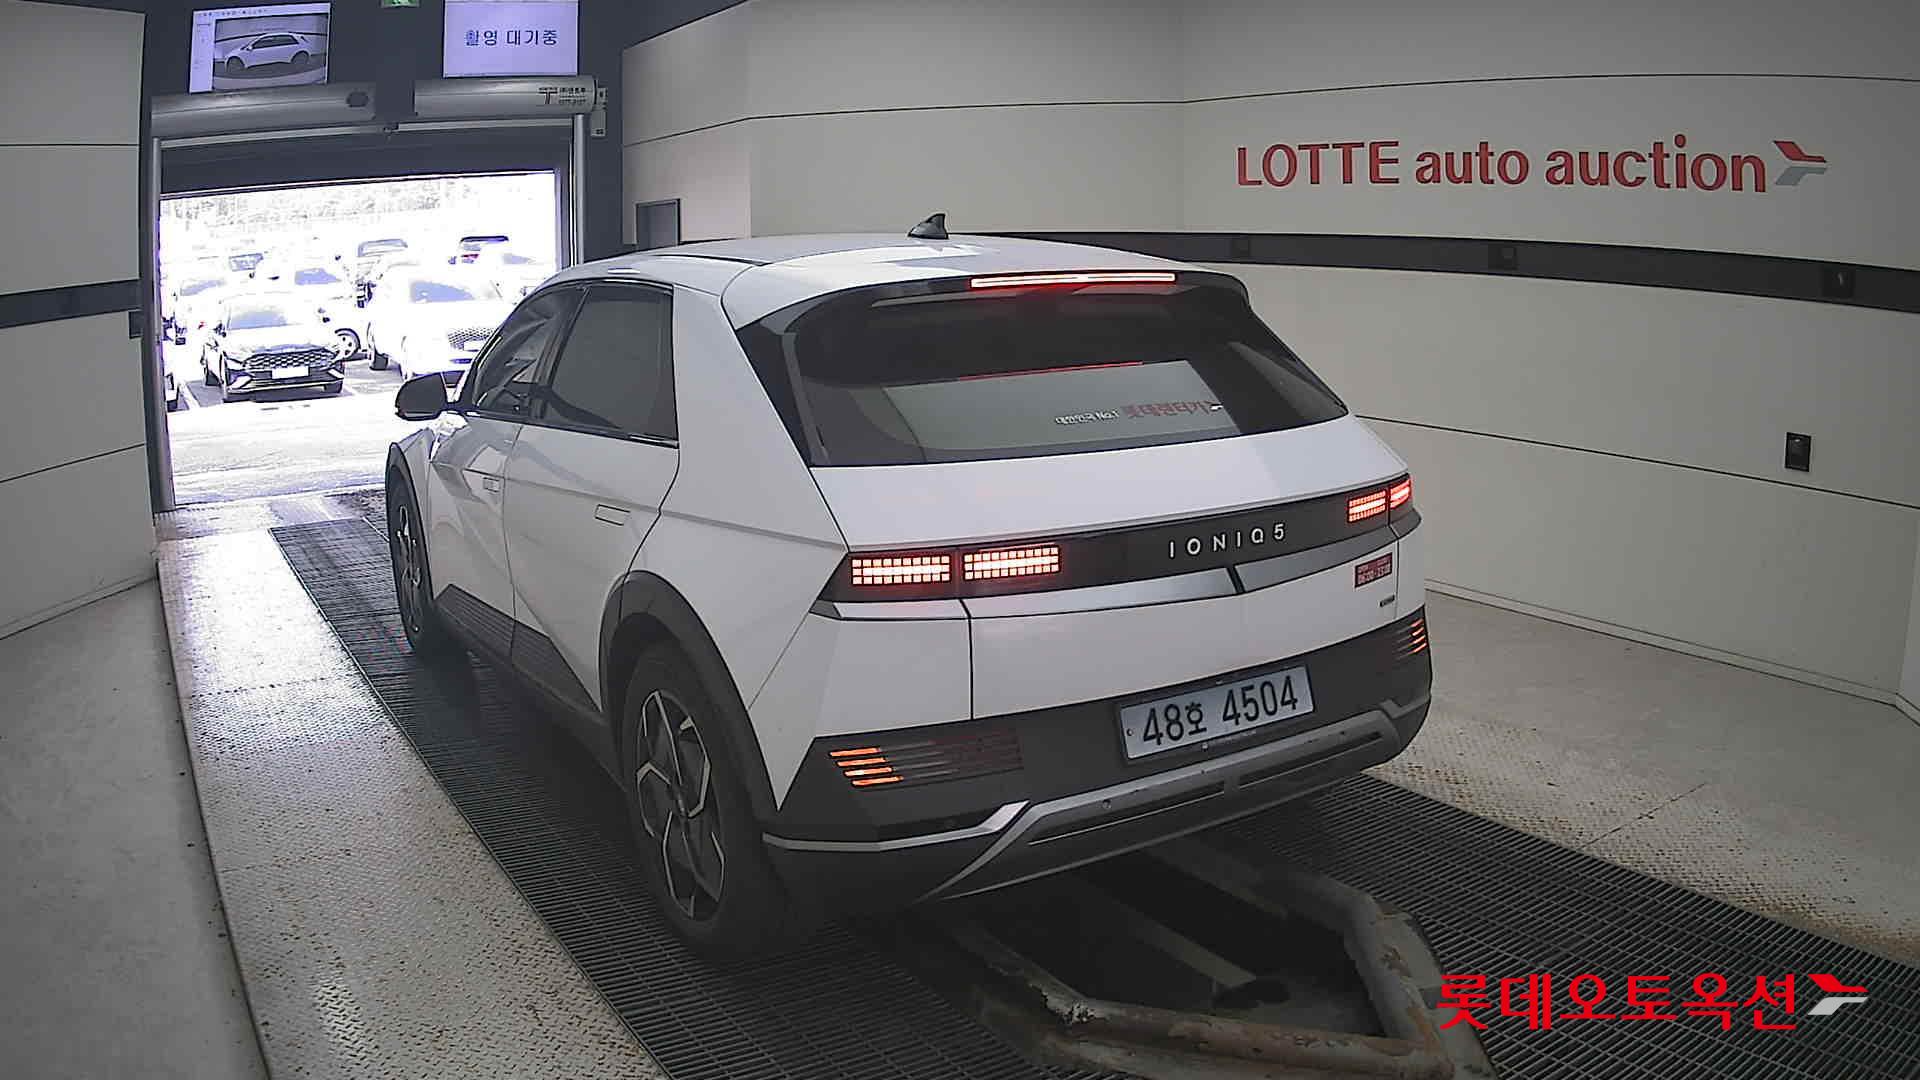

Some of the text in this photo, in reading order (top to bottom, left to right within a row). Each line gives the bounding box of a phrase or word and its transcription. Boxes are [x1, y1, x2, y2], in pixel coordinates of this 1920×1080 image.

[506, 30, 558, 46] 대기중
[1237, 134, 1766, 192] LOTTE auto auction
[1169, 523, 1285, 558] IONIQ 5
[1143, 675, 1298, 746] 48호 4504
